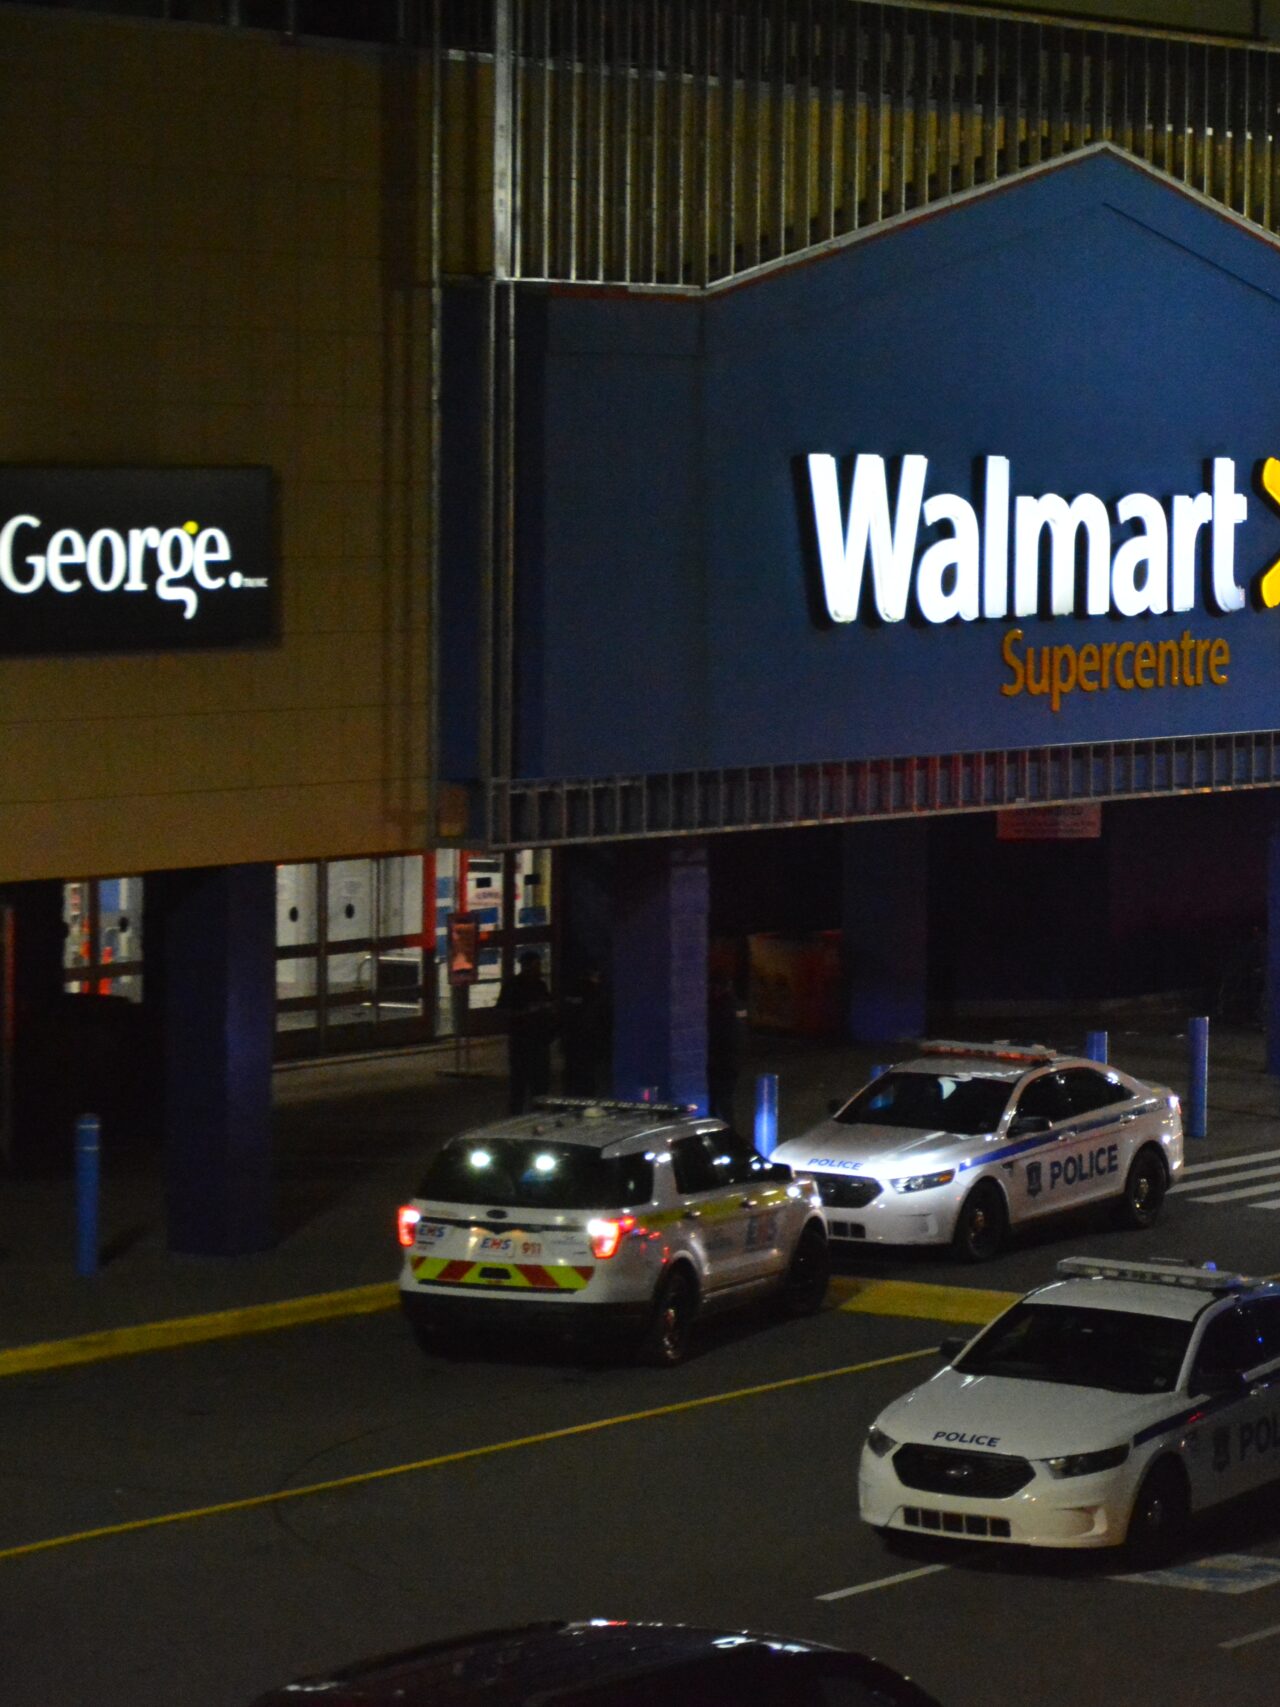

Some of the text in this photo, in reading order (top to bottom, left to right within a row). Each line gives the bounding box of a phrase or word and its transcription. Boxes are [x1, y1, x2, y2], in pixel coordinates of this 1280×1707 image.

[808, 453, 1248, 624] Walmart
[1001, 629, 1231, 712] Supercentre
[807, 1158, 864, 1171] POLICE
[1050, 1144, 1118, 1190] POLICE
[418, 1225, 445, 1239] EMS
[480, 1237, 511, 1251] EMS
[932, 1430, 1001, 1447] POLICE
